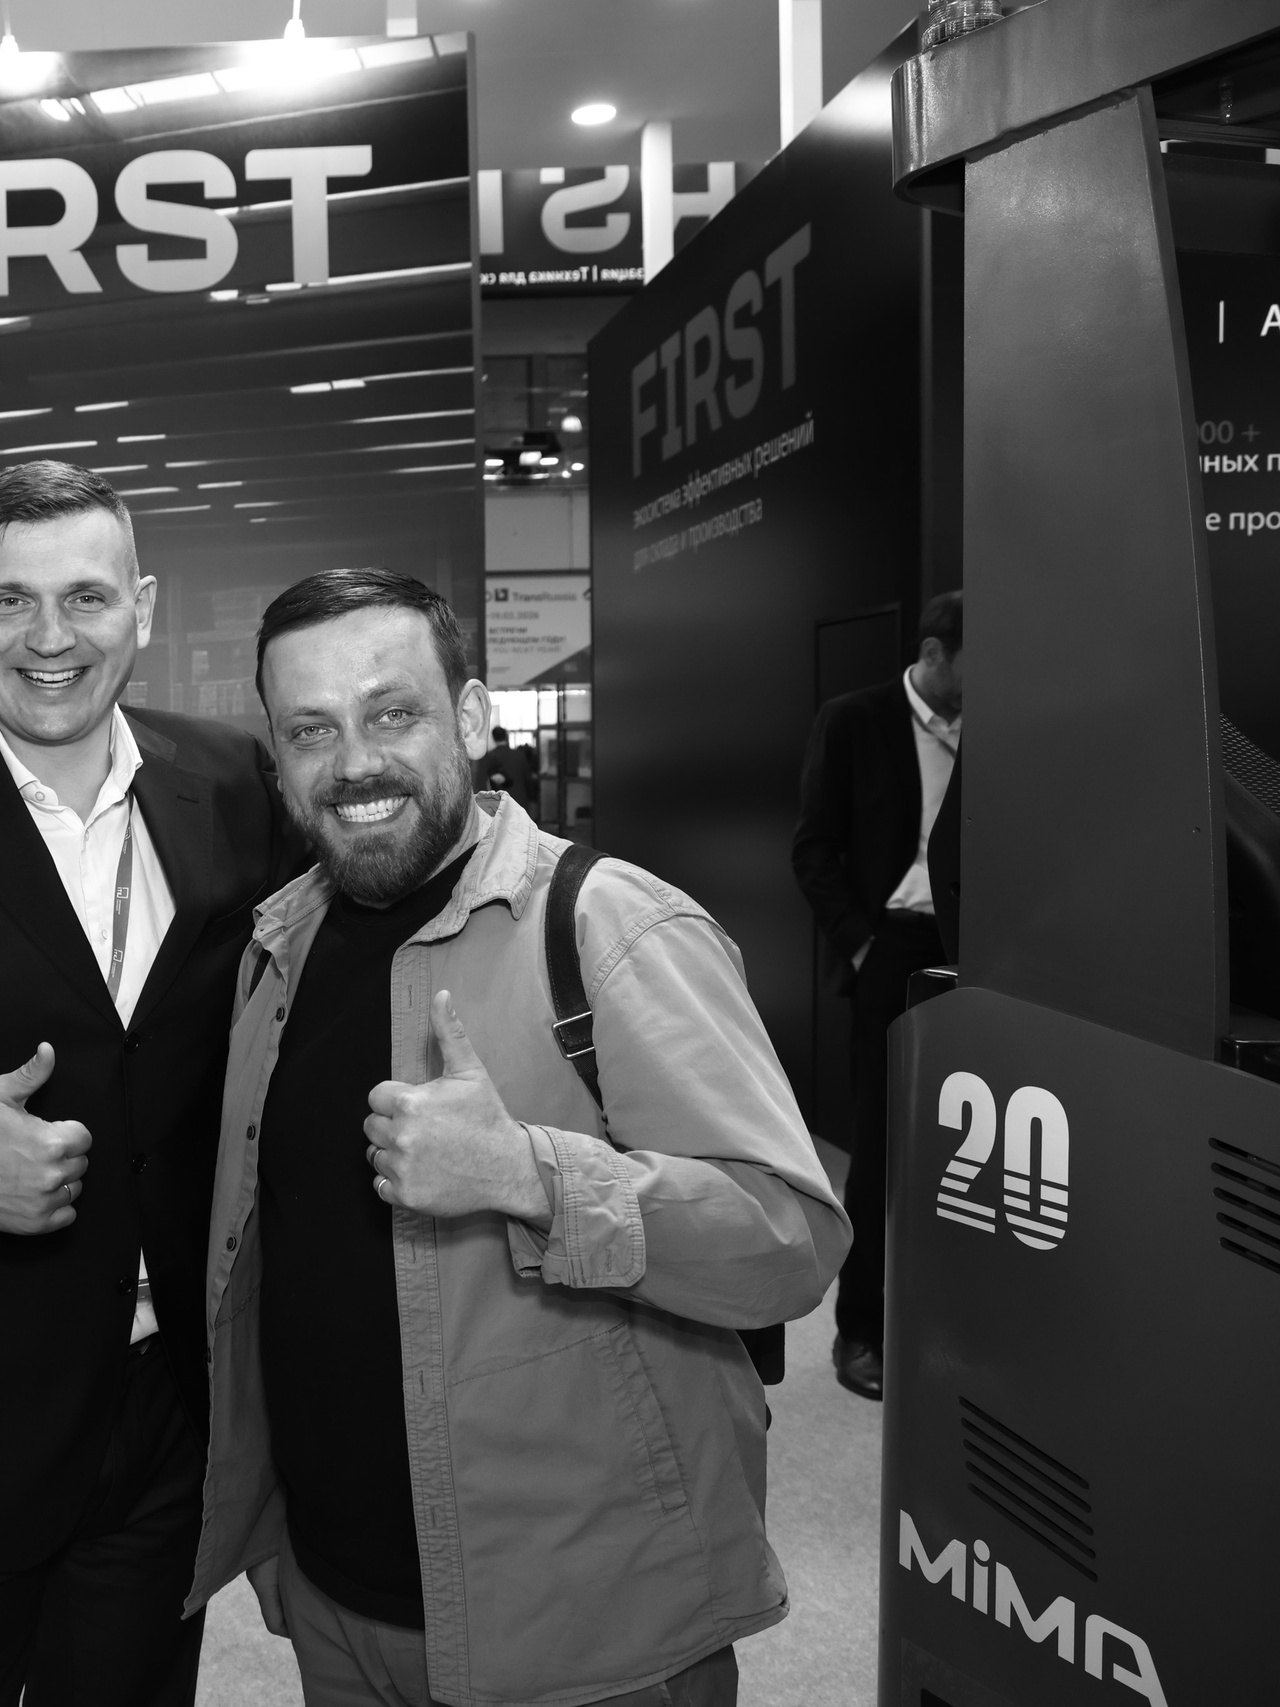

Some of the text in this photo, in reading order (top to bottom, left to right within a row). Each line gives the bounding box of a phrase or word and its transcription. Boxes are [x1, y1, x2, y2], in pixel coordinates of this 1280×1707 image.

[631, 221, 812, 480] FIRST
[682, 451, 753, 510] эффективных
[753, 410, 814, 478] решений
[1197, 420, 1234, 444] 00
[1199, 454, 1260, 473] ных
[689, 498, 763, 552] производства
[936, 1071, 1070, 1251] 20
